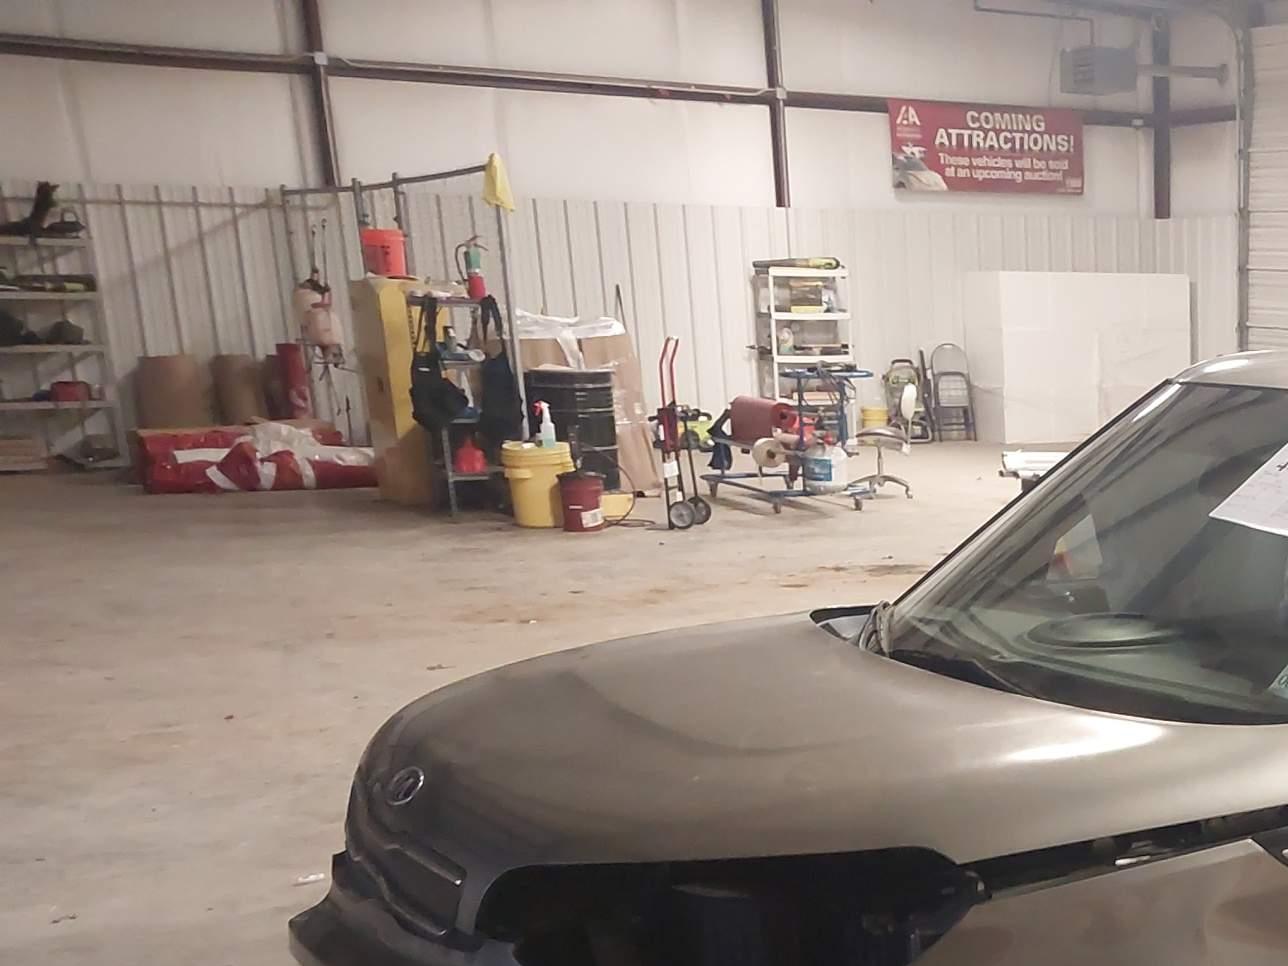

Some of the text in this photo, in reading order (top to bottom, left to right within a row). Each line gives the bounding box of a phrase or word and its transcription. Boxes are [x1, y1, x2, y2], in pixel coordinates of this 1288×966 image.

[965, 110, 1046, 132] COMING
[934, 128, 1075, 153] ATTRACTIONS!
[938, 152, 970, 166] These
[971, 155, 1013, 168] vehicles
[1014, 157, 1032, 169] will
[1032, 158, 1047, 169] be
[944, 166, 956, 177] at
[957, 167, 971, 178] an
[972, 168, 1023, 184] upcoming
